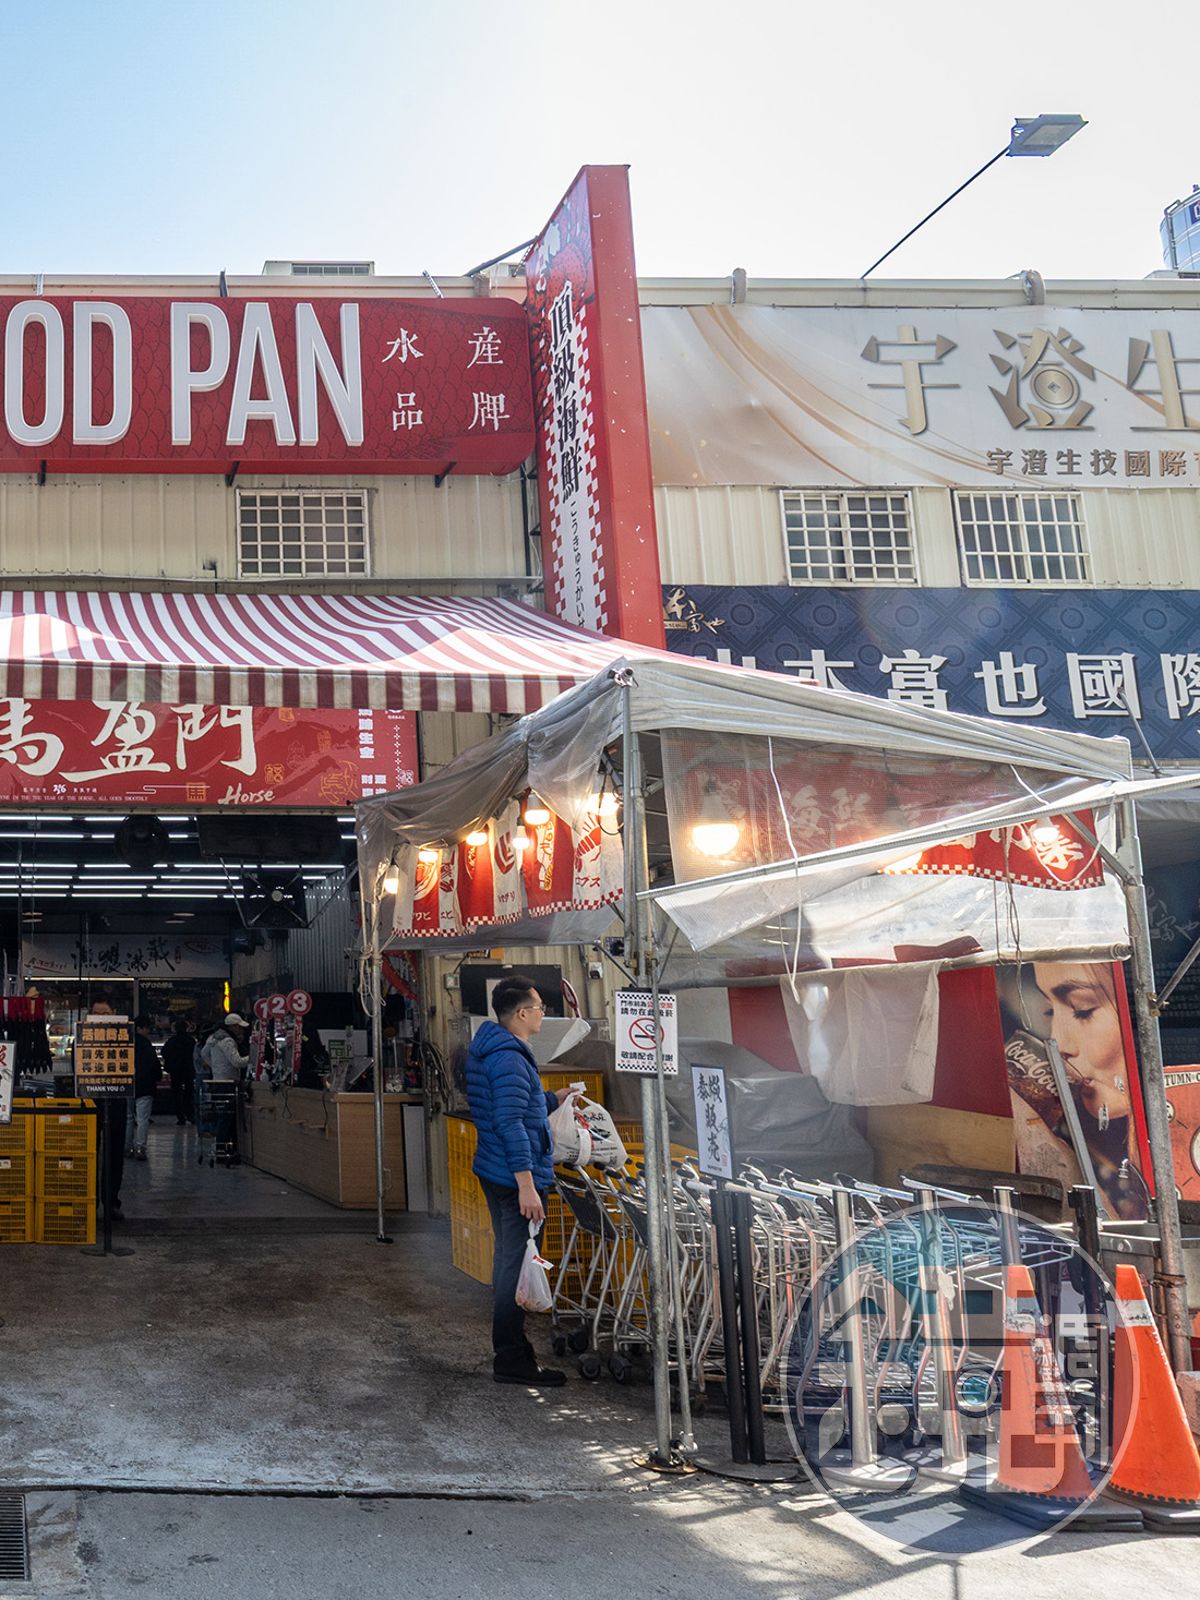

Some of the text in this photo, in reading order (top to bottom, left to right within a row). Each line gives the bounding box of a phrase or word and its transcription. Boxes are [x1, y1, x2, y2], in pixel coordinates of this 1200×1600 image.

[170, 302, 363, 446] PAN
[550, 286, 582, 503] 頂級海鮮
[392, 391, 510, 431] 品牌
[987, 448, 1200, 477] 宇澄生技國際
[217, 783, 276, 804] Horse
[260, 1003, 268, 1018] 1
[272, 997, 286, 1013] 2
[292, 993, 307, 1012] 3
[621, 1000, 673, 1009] 門市前為公空間
[621, 1051, 674, 1062] 敬請配合謝
[1164, 1072, 1191, 1086] TUMN
